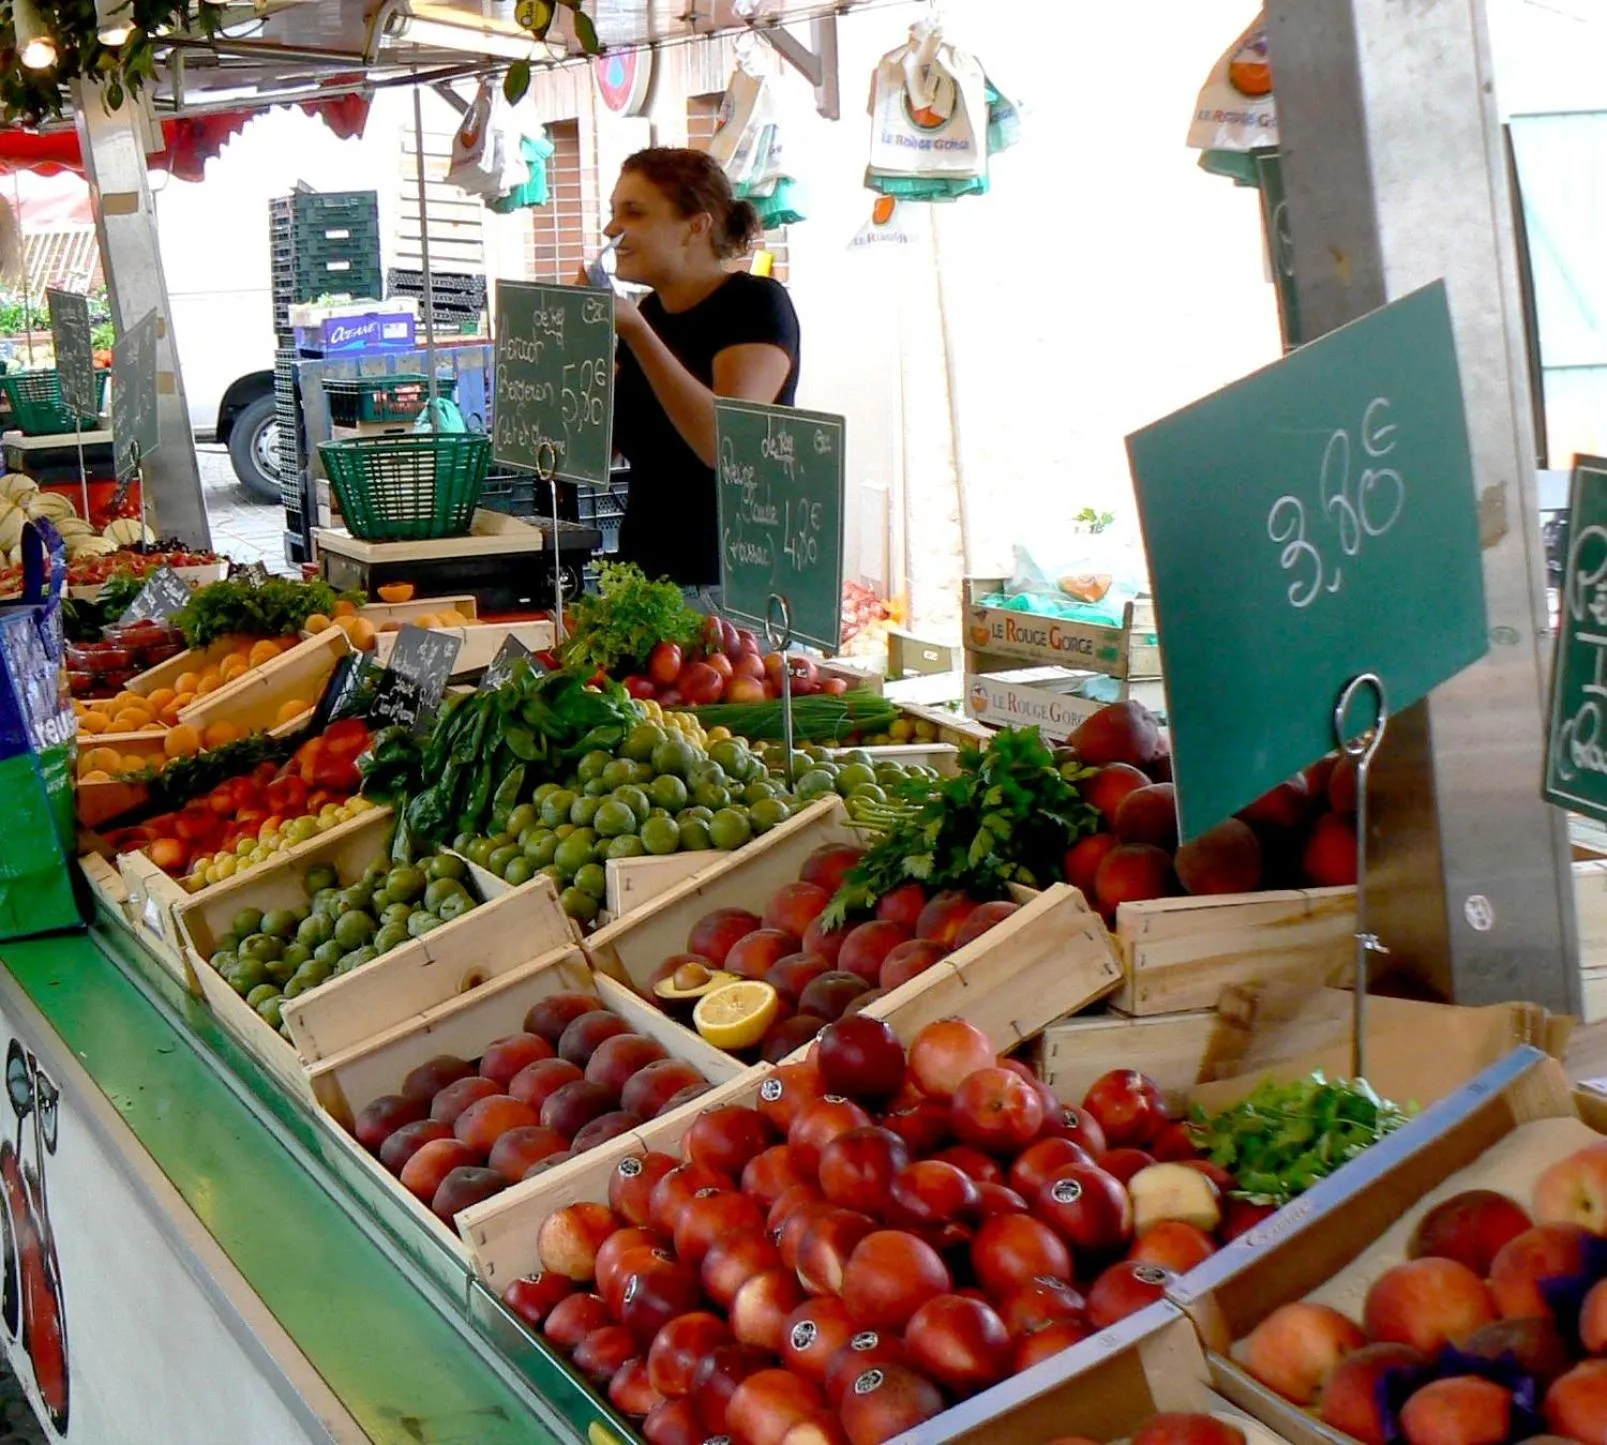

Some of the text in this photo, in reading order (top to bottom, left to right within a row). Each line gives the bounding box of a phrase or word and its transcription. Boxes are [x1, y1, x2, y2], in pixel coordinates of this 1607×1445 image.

[993, 623, 1004, 639] LE
[1006, 618, 1047, 646] ROUGE
[1050, 627, 1092, 655] GORGE
[994, 695, 1005, 710] LE
[1007, 692, 1049, 721] ROUGE
